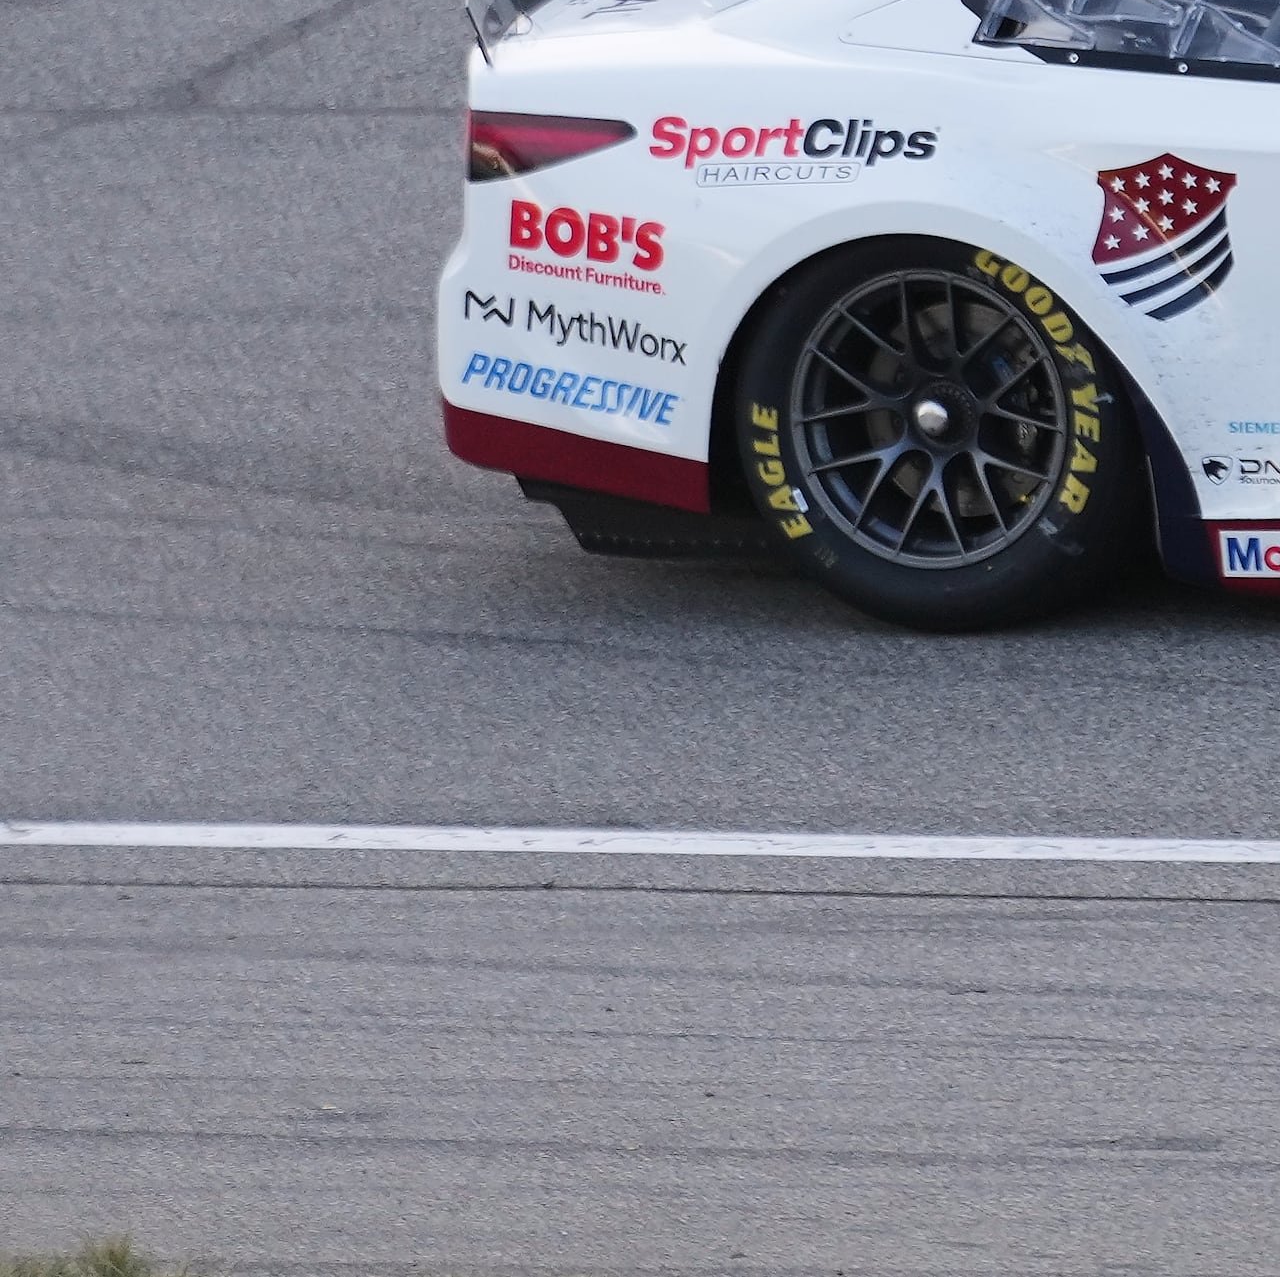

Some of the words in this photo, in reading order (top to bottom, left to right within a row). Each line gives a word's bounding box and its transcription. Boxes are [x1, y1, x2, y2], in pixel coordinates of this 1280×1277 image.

[649, 116, 937, 169] SportClips
[702, 164, 854, 184] HAIRCUTS
[508, 199, 667, 272] BOB'S
[508, 254, 583, 282] Discount
[528, 299, 687, 366] MythWorx
[461, 352, 680, 425] PROGRESSIVE
[751, 402, 814, 540] EAGLE
